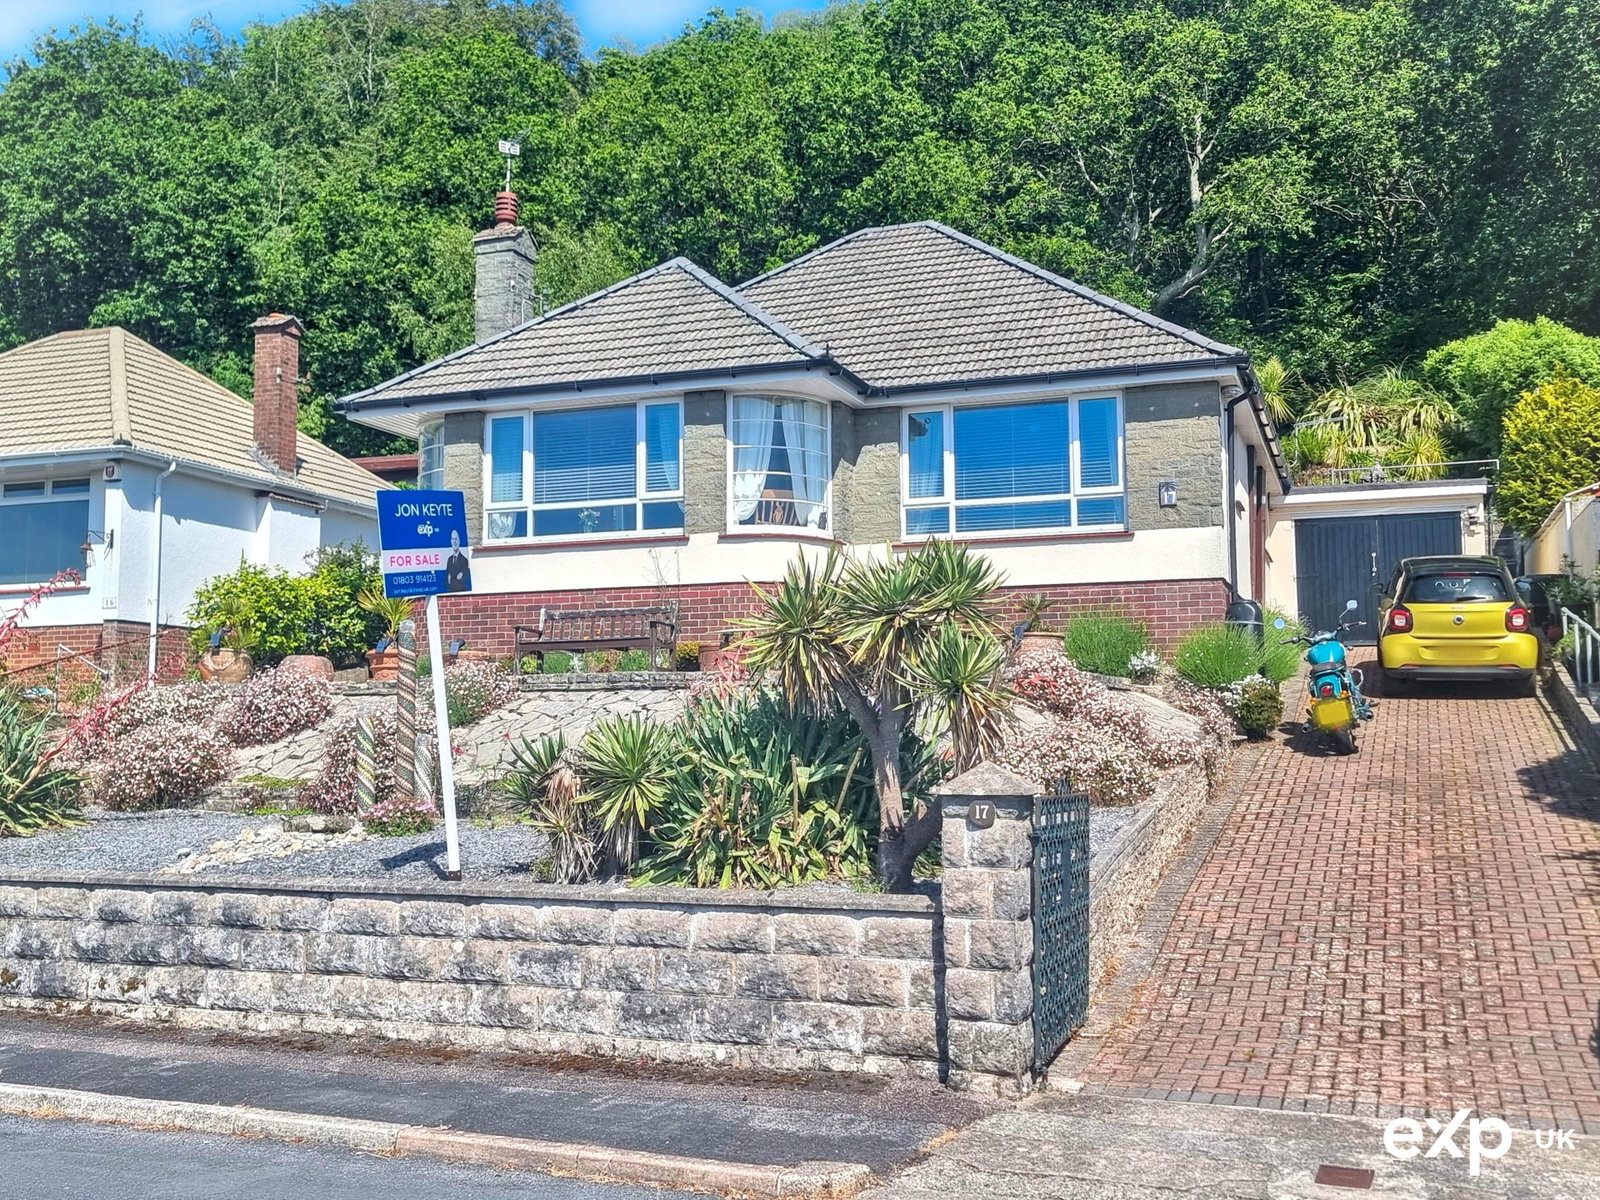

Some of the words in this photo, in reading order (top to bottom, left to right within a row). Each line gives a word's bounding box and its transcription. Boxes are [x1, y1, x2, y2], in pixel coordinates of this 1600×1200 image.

[1164, 491, 1176, 504] 17
[395, 504, 419, 517] JON
[422, 504, 453, 516] KEYTE
[390, 556, 412, 567] FOR
[415, 554, 440, 565] SALE
[393, 576, 414, 585] 01803
[975, 805, 989, 819] 17
